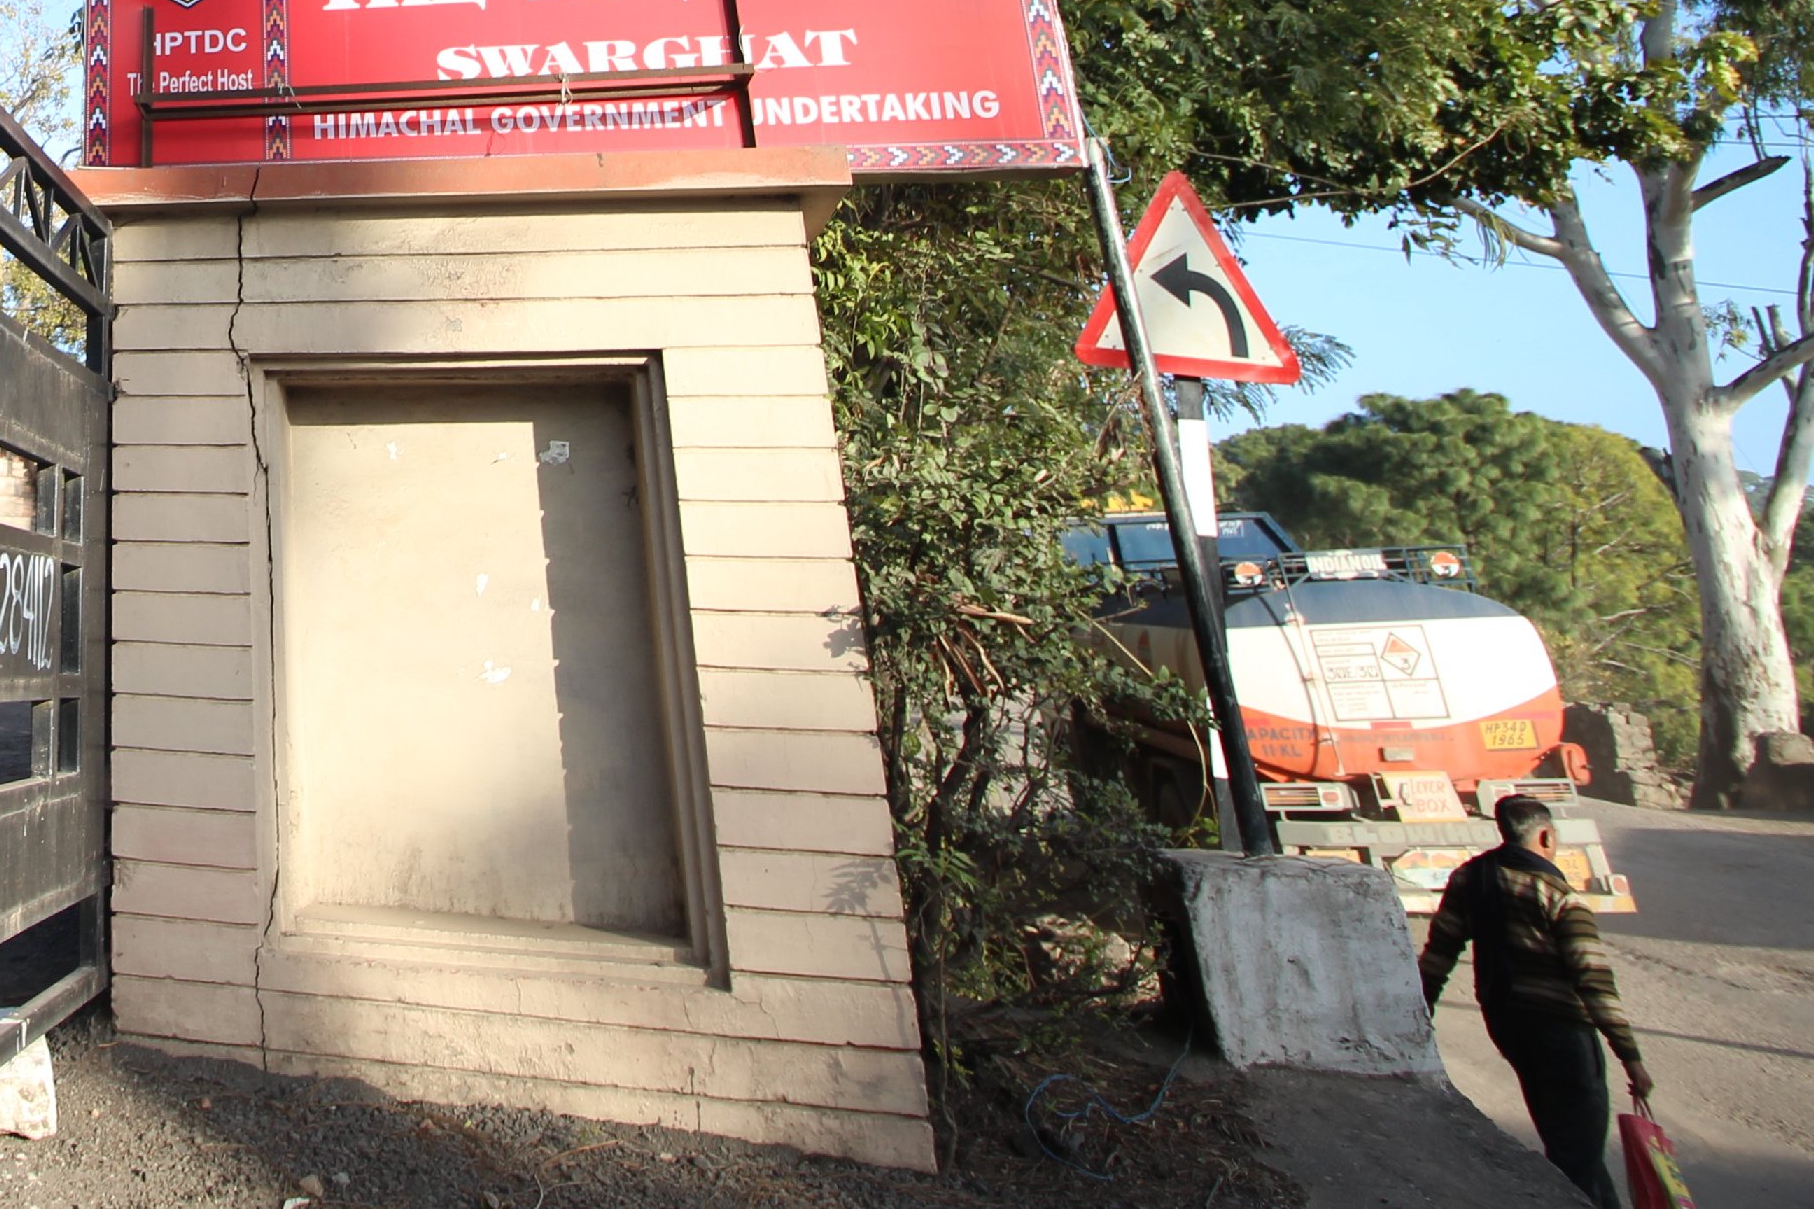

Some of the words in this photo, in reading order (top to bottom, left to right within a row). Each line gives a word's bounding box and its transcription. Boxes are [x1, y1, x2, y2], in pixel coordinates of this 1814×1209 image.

[435, 28, 858, 81] SWARGHAT
[159, 70, 214, 93] Perfect
[217, 68, 253, 91] Host
[313, 106, 482, 140] HIMACHAL
[490, 100, 727, 135] GOVERNMENT
[1248, 726, 1314, 741] APACITY
[1416, 798, 1451, 813] BOX
[1329, 824, 1436, 844] BLOW
